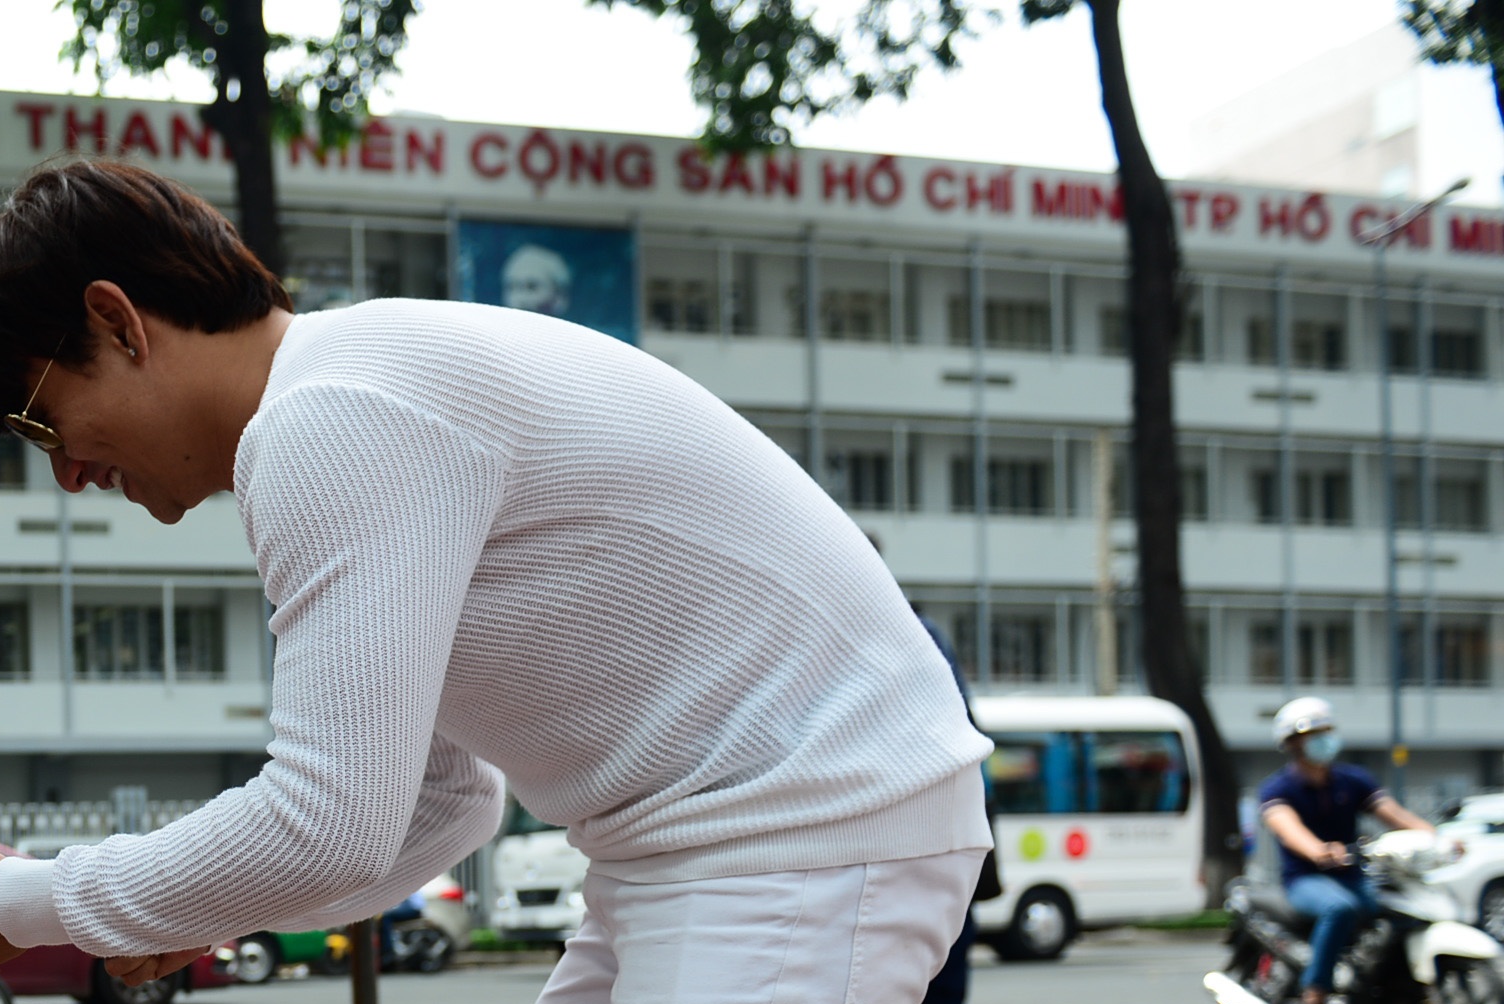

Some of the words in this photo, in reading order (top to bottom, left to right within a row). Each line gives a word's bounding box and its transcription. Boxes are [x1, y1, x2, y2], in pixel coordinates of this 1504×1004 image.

[14, 101, 235, 162] THAN
[468, 127, 654, 199] CỘNG
[922, 164, 1015, 215] CHÍ
[1030, 178, 1128, 222] MIN
